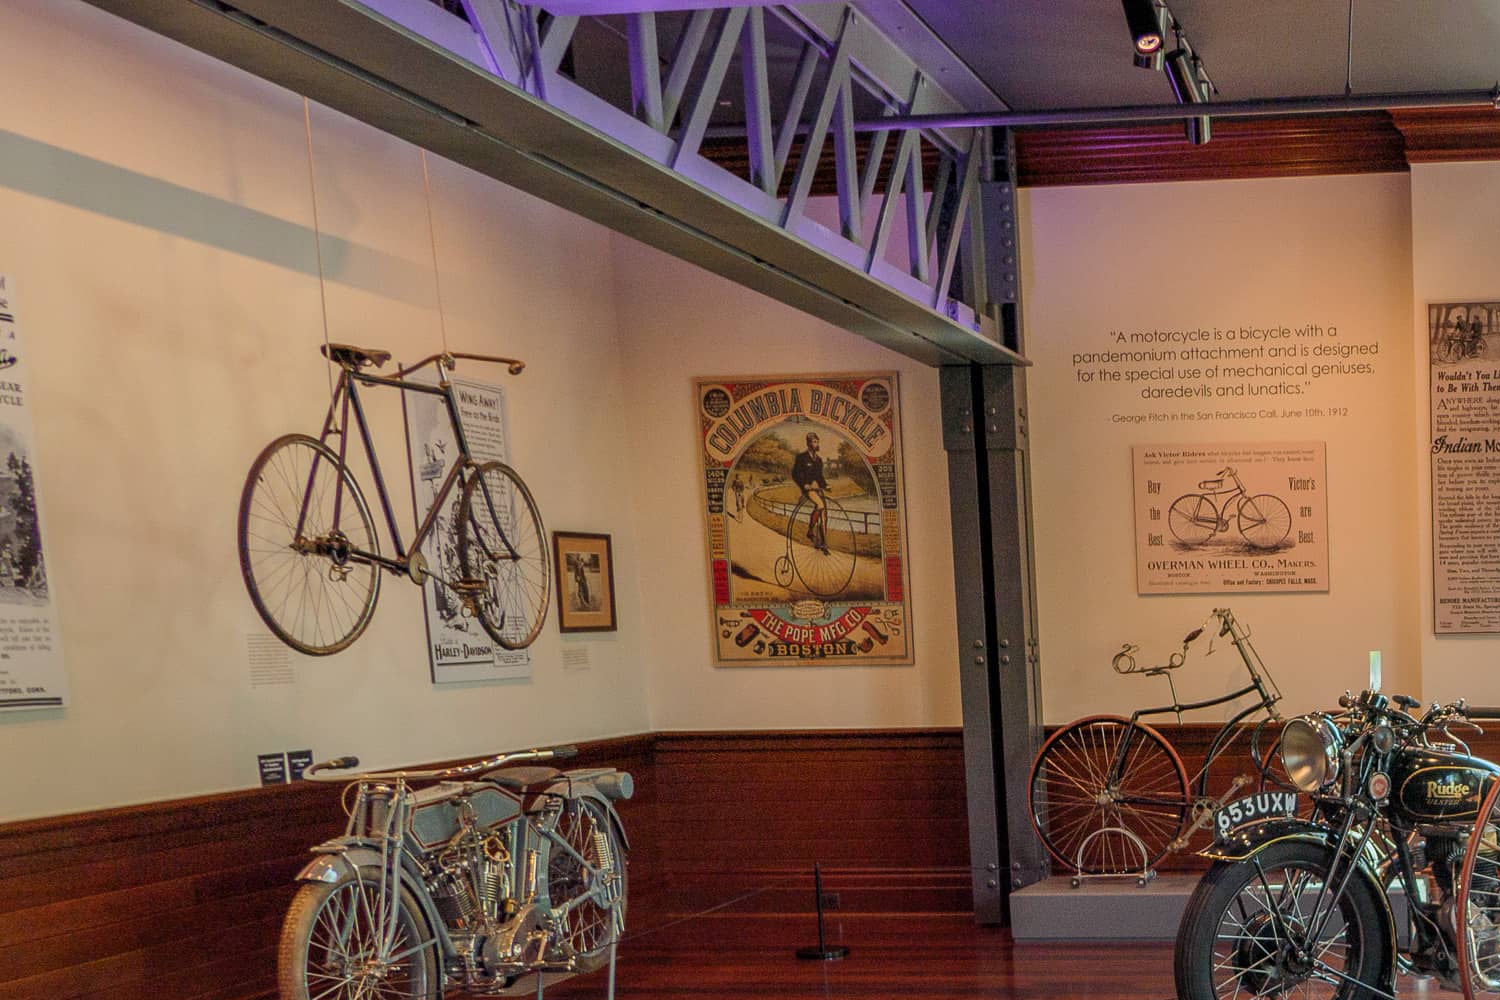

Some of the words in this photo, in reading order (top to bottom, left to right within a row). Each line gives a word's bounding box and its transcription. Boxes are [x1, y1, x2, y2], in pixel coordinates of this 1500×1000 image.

[1110, 330, 1127, 343] "A
[1130, 328, 1210, 344] motorcycle
[1213, 327, 1222, 341] is
[1226, 330, 1236, 340] a
[1240, 326, 1291, 341] bicycle
[1294, 324, 1323, 337] with
[1327, 327, 1337, 337] a
[1072, 349, 1176, 366] pandemonium
[1180, 345, 1264, 360] attachment
[1268, 344, 1297, 358] and
[1300, 343, 1309, 356] is
[1313, 341, 1379, 358] designed
[1077, 368, 1095, 382] for
[1099, 368, 1121, 381] the
[1125, 367, 1174, 383] special
[1178, 368, 1201, 379] use
[1205, 365, 1218, 378] of
[1223, 363, 1308, 377] mechanical
[1438, 371, 1472, 381] Wouldn't
[1476, 371, 1490, 380] You
[1141, 384, 1213, 399] daredevils
[1216, 383, 1244, 397] and
[1248, 381, 1311, 396] lunatics."
[1437, 385, 1445, 393] to
[1448, 384, 1457, 392] Be
[1461, 383, 1479, 392] With
[709, 387, 803, 455] COLUMBIA
[1112, 413, 1146, 424] George
[1149, 412, 1169, 422] Fitch
[1171, 413, 1178, 421] in
[1180, 411, 1194, 421] the
[1196, 411, 1214, 420] San
[1216, 410, 1257, 420] Francisco
[1281, 408, 1302, 418] June
[1328, 407, 1349, 417] 1912
[1431, 435, 1483, 454] Indian
[1148, 481, 1161, 495] Buy
[1288, 477, 1316, 491] Victor's
[1150, 507, 1161, 520] the
[1299, 506, 1312, 518] are
[1147, 560, 1207, 571] OVERMAN
[1208, 559, 1249, 570] WHEEL
[760, 612, 782, 635] THE
[784, 626, 816, 644] POPE
[777, 642, 848, 657] BOSTON
[1426, 780, 1470, 798] Rudge
